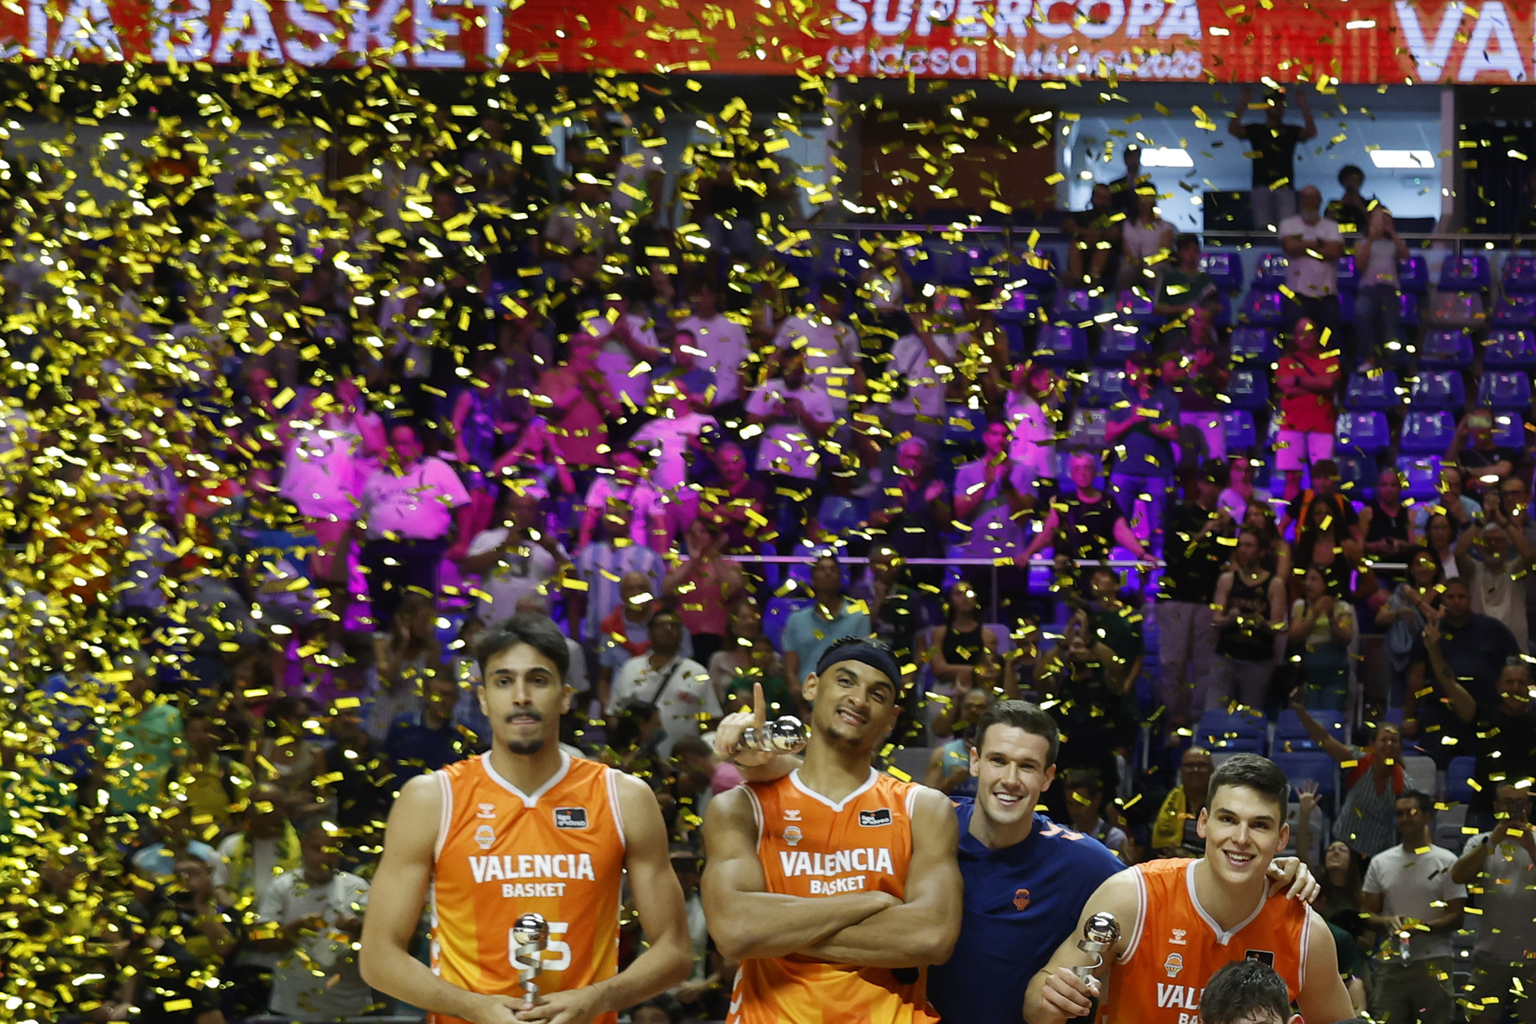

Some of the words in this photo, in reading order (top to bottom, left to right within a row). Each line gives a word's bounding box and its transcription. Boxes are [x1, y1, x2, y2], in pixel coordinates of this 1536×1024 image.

[0, 0, 125, 62] IA
[152, 0, 503, 68] BASKET
[833, 0, 1203, 39] SUPERCOPA
[826, 45, 977, 76] endesa
[469, 853, 595, 884] VALENCIA
[779, 848, 894, 877] VALENCIA
[502, 882, 566, 898] BASKET
[810, 875, 866, 895] BASKET
